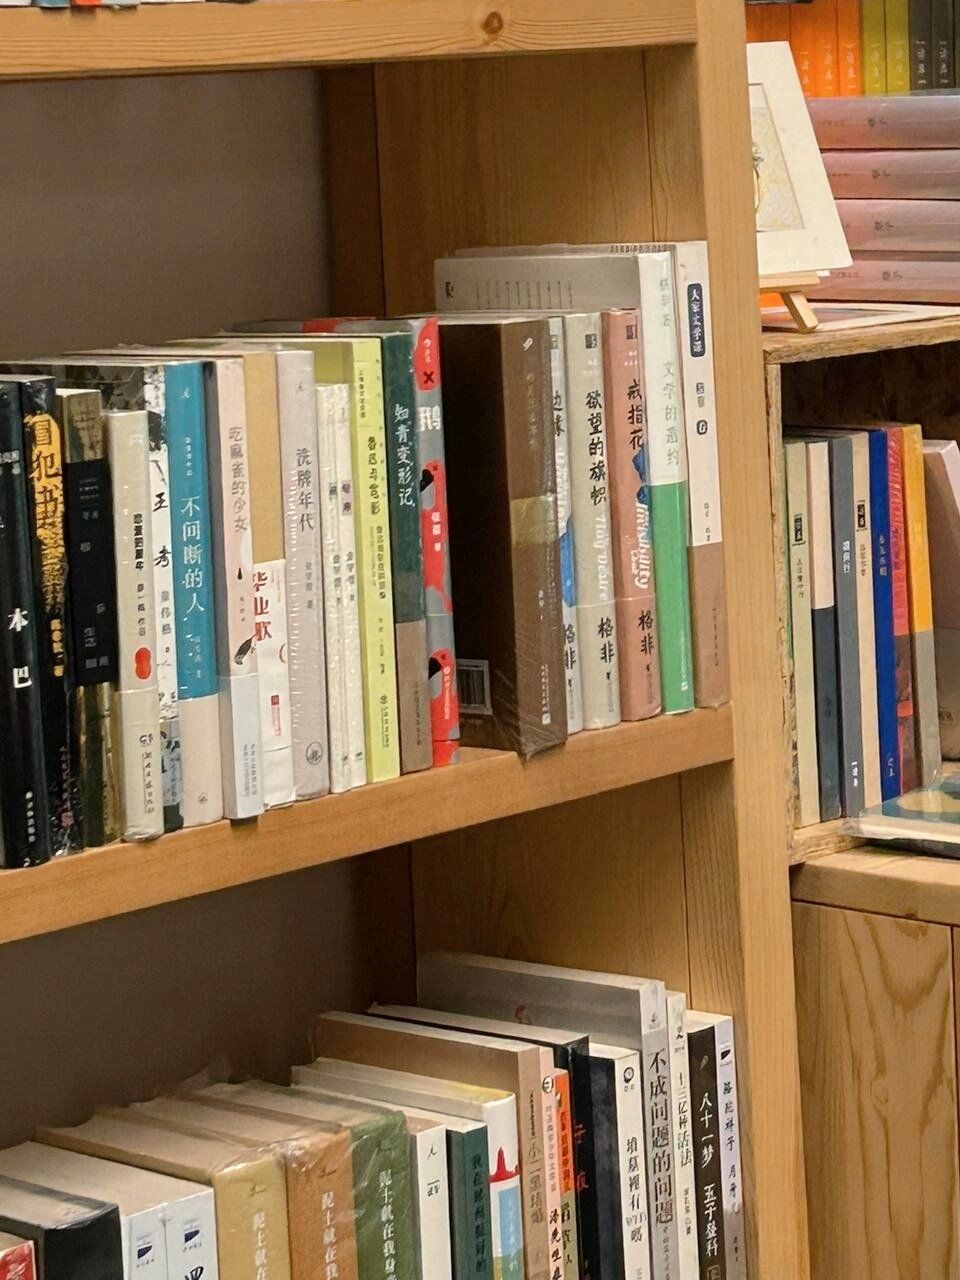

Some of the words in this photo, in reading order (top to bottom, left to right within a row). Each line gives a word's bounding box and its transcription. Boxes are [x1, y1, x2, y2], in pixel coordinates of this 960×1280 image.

[29, 415, 62, 530] 冒犯书
[228, 425, 249, 534] 吃麻雀的少女
[295, 447, 316, 532] 洗牌年代
[394, 402, 416, 508] 知青变形记
[585, 390, 608, 507] 欲望的旗帜
[152, 490, 172, 570] 王考
[180, 495, 206, 614] 不间断的人
[251, 569, 273, 642] 毕业歌
[599, 616, 615, 664] 格非
[638, 610, 655, 657] 格非
[8, 607, 33, 689] 本巴
[649, 1047, 674, 1224] 不成问题的问题
[699, 1092, 714, 1169] 八十一梦
[704, 1183, 719, 1257] 五子登科
